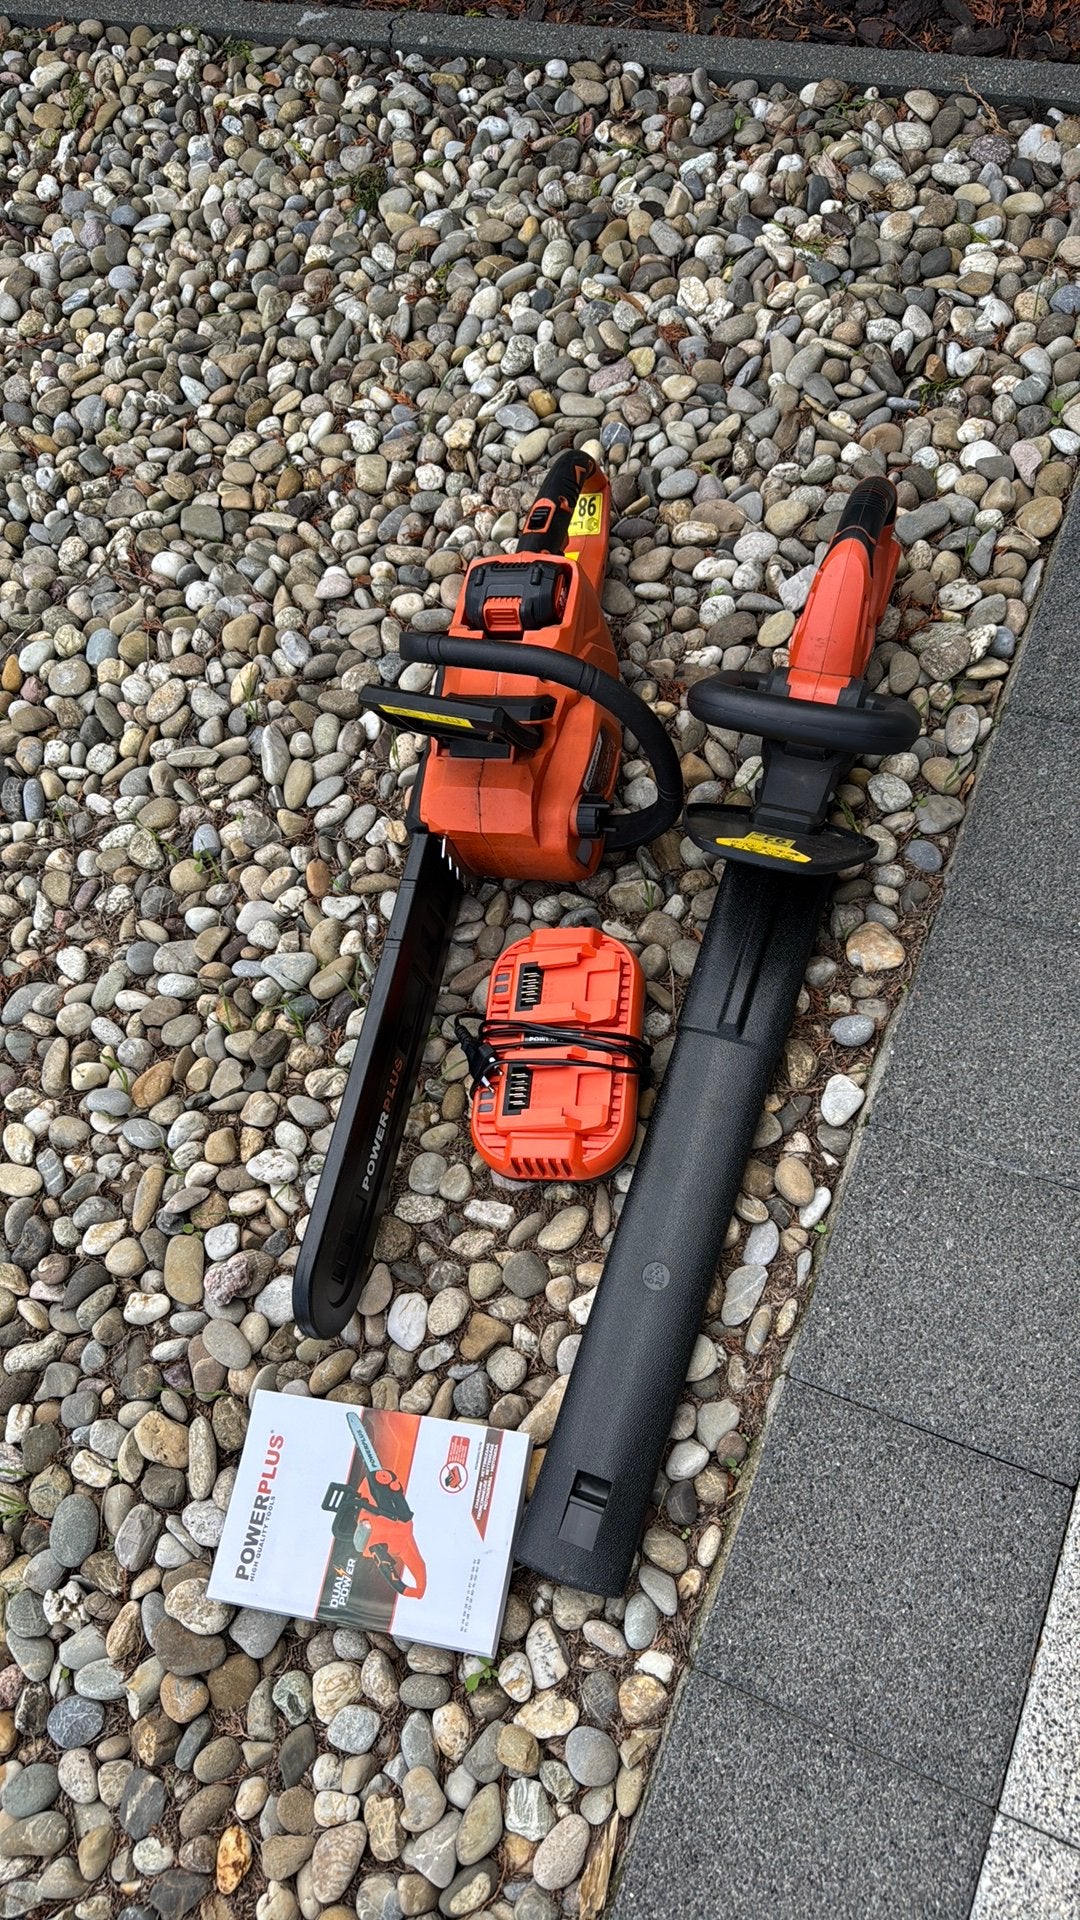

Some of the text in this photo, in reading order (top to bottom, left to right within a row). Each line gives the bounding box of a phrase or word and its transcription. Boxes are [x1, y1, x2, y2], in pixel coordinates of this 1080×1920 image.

[362, 1056, 404, 1192] POWERPLUS
[357, 1429, 377, 1468] POWERPLUS
[235, 1434, 284, 1581] POWERPLUS
[249, 1496, 276, 1582] HIGH QUALITY TOOLS
[330, 1576, 344, 1608] DUAL
[339, 1558, 356, 1606] POWER
